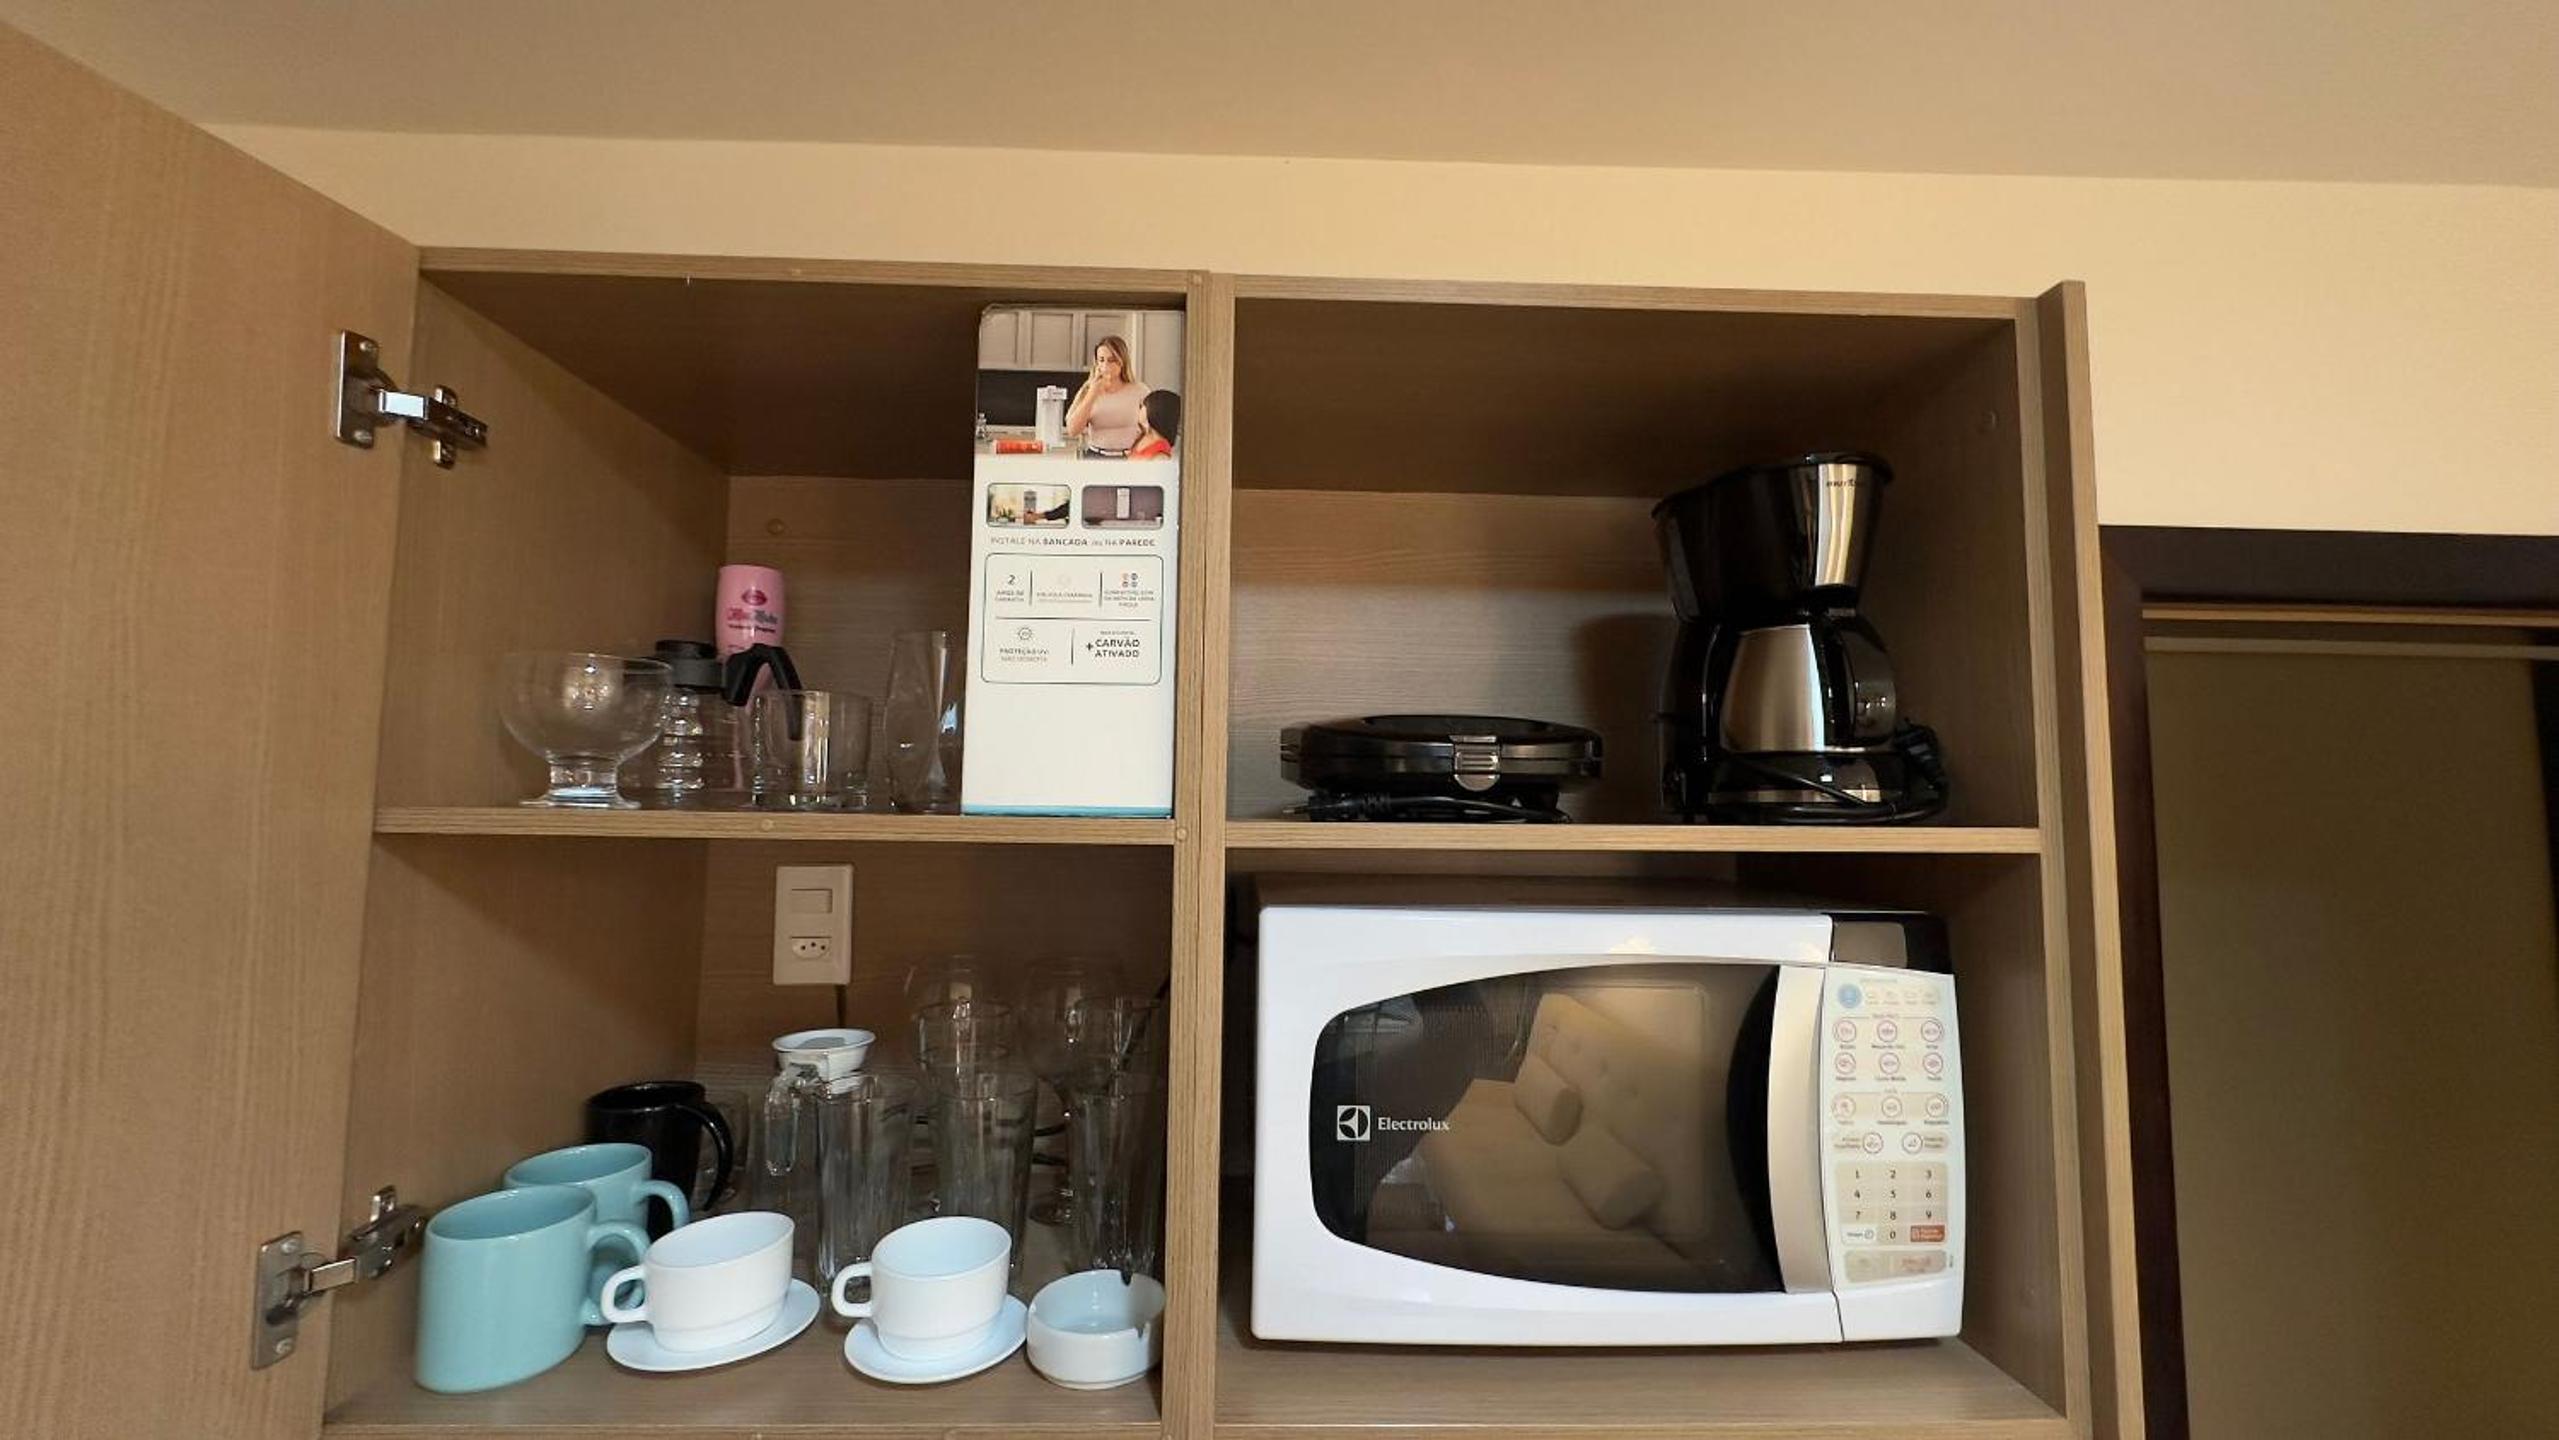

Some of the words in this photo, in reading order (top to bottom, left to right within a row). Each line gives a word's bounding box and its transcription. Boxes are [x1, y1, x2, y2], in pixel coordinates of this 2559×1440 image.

[1043, 537, 1088, 547] BANCADA
[1119, 538, 1156, 547] PAREDE
[1007, 574, 1016, 585] 2
[1094, 637, 1141, 648] CARVÃO
[1094, 649, 1140, 658] ATIVADO
[1377, 1116, 1451, 1131] Electrolux
[1889, 1169, 1897, 1179] 2
[1925, 1169, 1932, 1179] 3
[1853, 1189, 1861, 1199] 4
[1889, 1189, 1897, 1199] 5
[1925, 1189, 1932, 1199] 6
[1889, 1210, 1897, 1221] 8
[1925, 1210, 1932, 1220] 9
[1889, 1230, 1897, 1240] 0
